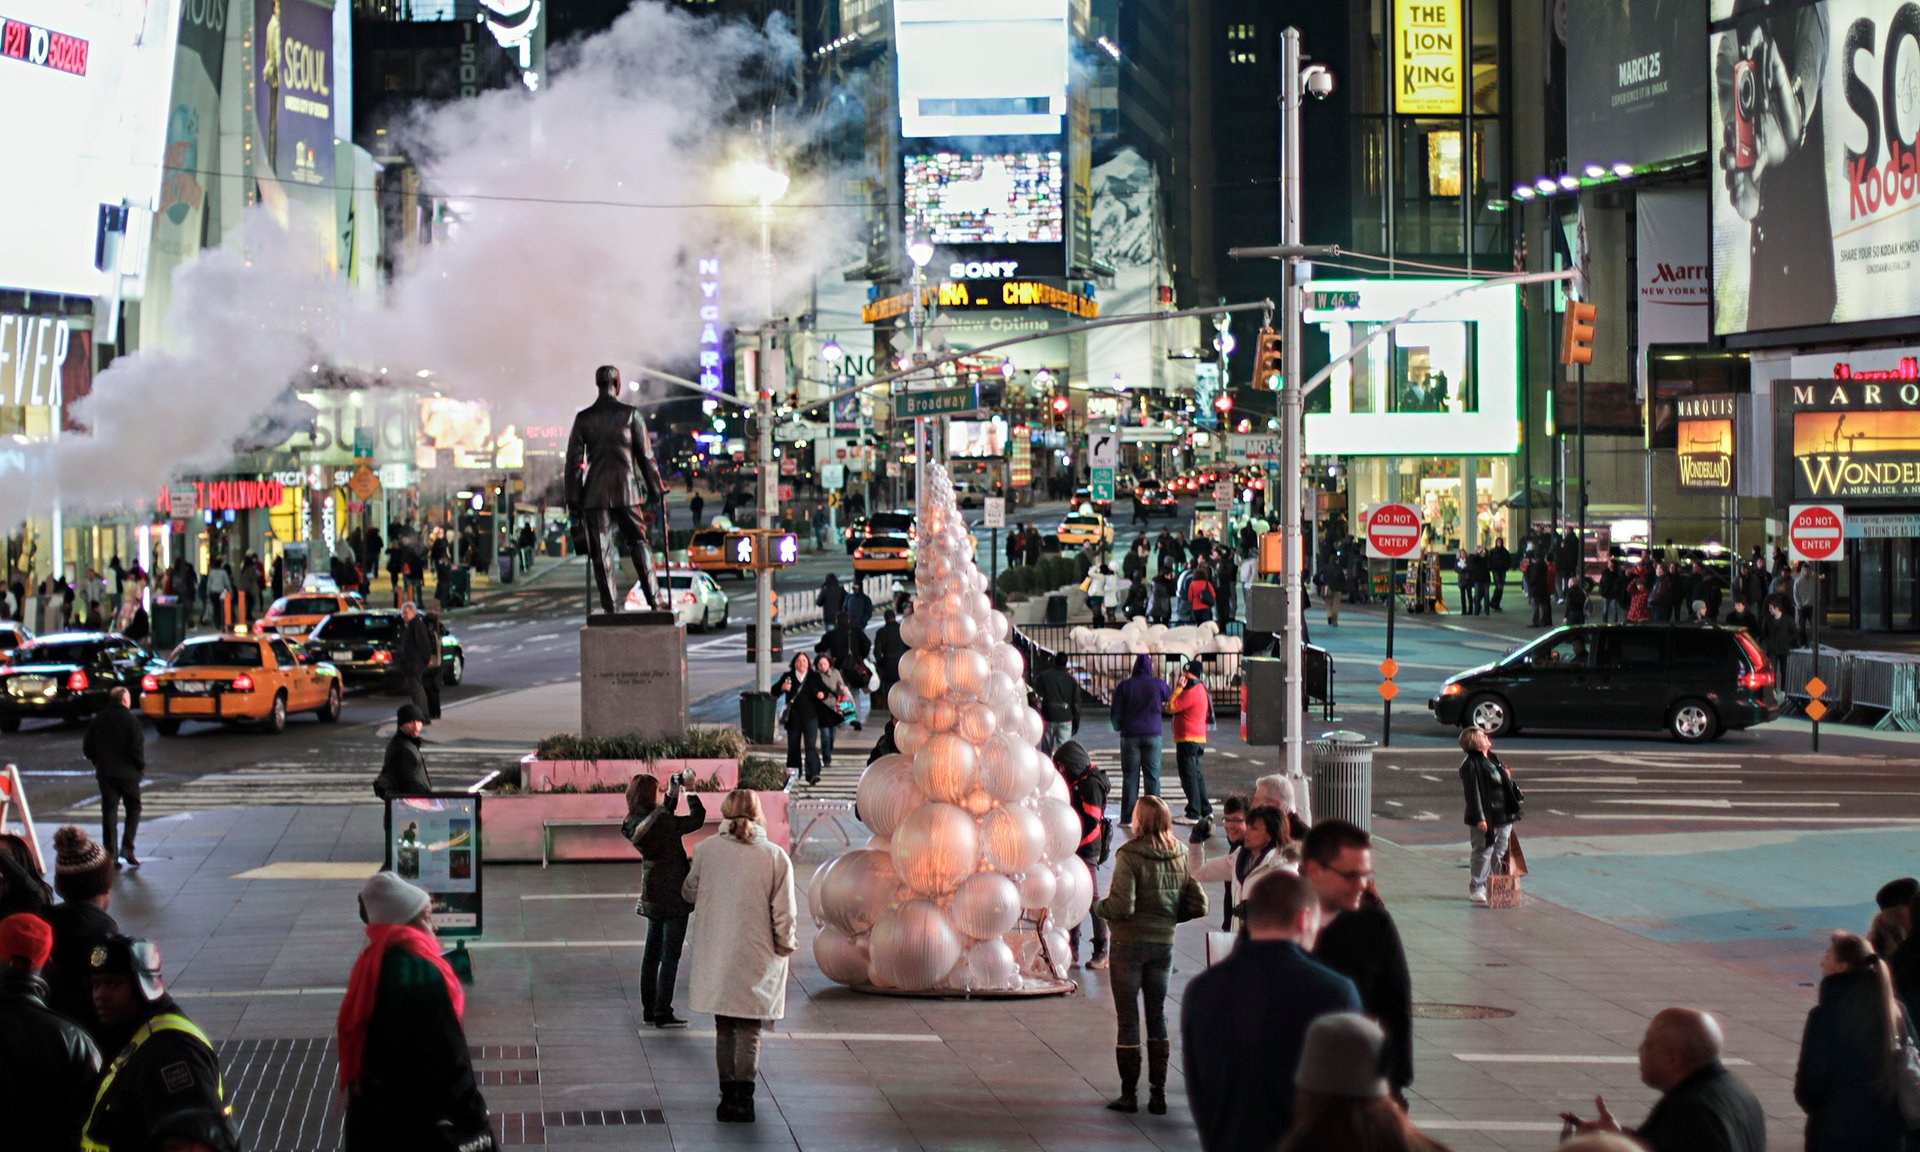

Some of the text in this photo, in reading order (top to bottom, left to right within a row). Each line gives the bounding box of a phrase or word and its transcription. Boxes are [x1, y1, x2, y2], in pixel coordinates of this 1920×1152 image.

[1409, 6, 1446, 22] THE
[4, 20, 28, 58] F21
[48, 33, 88, 75] 50203
[1403, 30, 1453, 59] LION
[284, 37, 329, 97] SEOUL
[1619, 51, 1661, 88] MARCH 25
[1403, 65, 1455, 95] KING
[1880, 243, 1898, 257] KODAK
[1899, 239, 1920, 254] MOMEN
[950, 262, 1018, 279] SONY
[1641, 287, 1664, 295] NEW
[1667, 287, 1696, 295] YORK
[1318, 292, 1327, 309] W
[1331, 293, 1345, 309] 46
[951, 316, 1049, 333] New Optima
[907, 395, 966, 413] Broadway
[1678, 399, 1733, 416] MARQUIS
[1680, 455, 1731, 487] WONDERLAND
[208, 480, 284, 510] HOLLYWOOD
[1850, 487, 1869, 495] NEW
[1377, 514, 1412, 524] DO NOT
[1800, 516, 1833, 526] DO NOT
[1863, 525, 1890, 537] NOTHING
[1379, 537, 1409, 548] ENTER
[1802, 540, 1832, 550] ENTER
